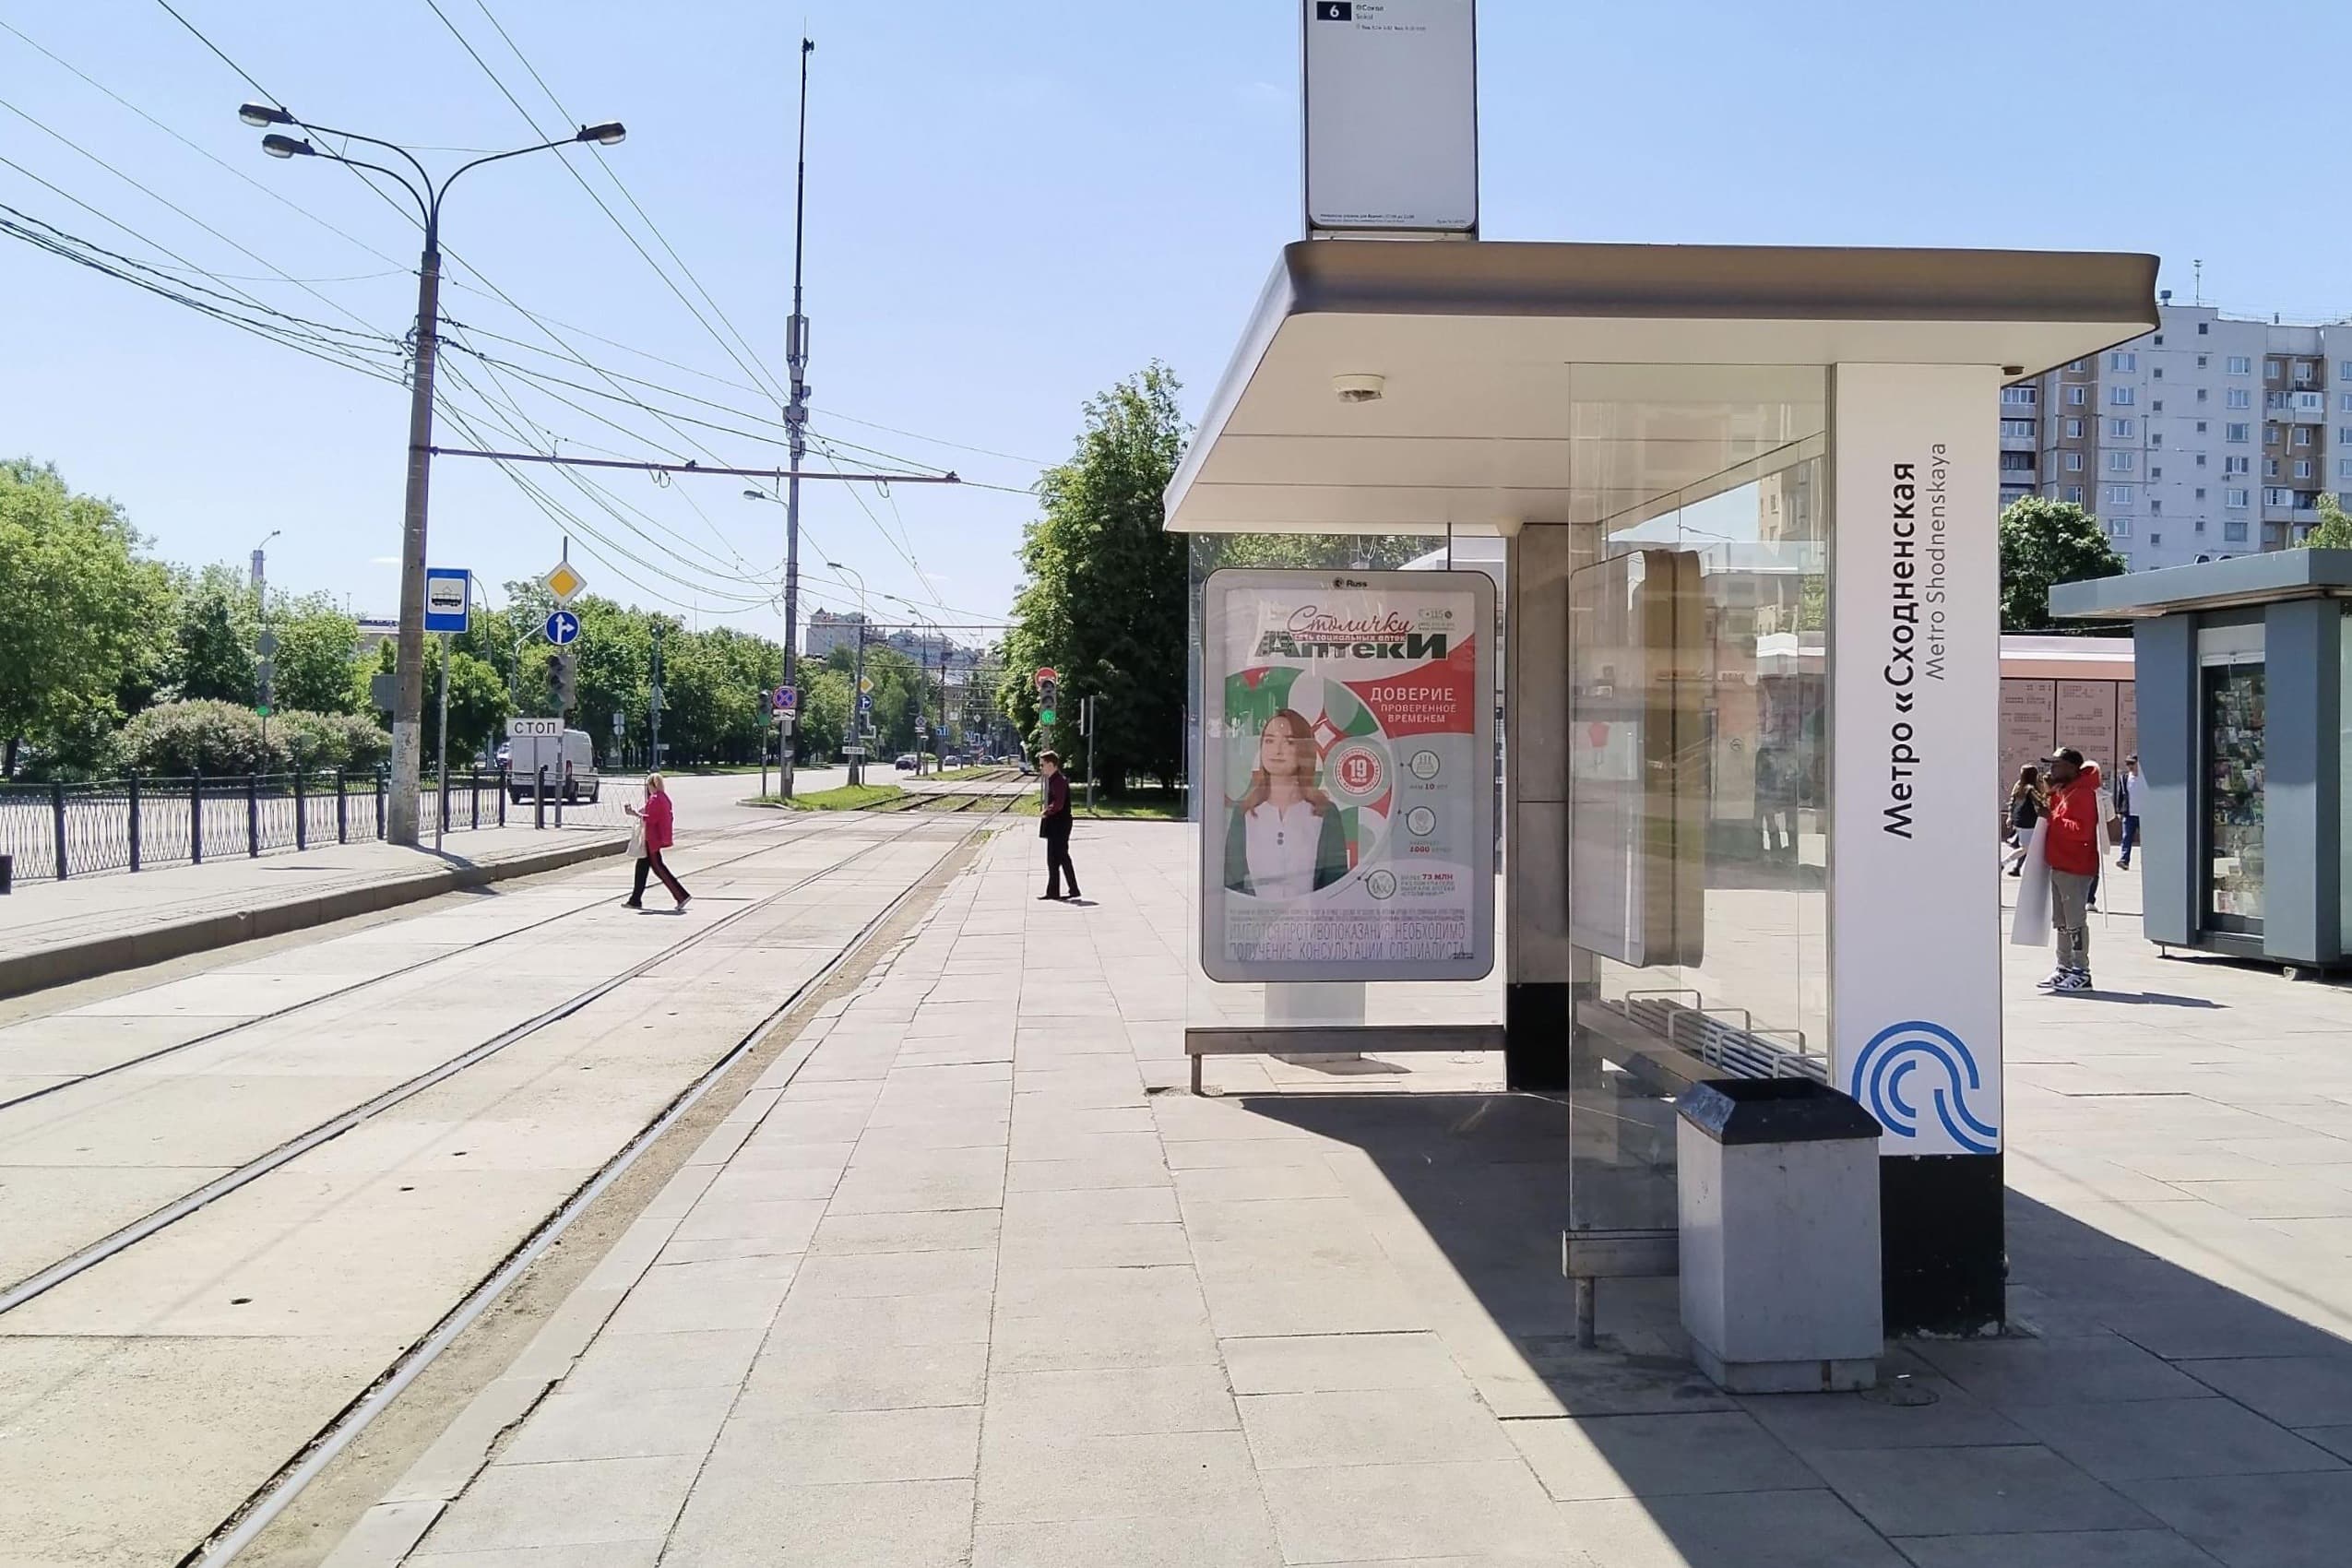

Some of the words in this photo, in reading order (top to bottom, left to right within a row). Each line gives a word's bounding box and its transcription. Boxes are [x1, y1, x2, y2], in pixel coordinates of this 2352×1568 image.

[1329, 6, 1339, 18] 6
[1925, 443, 1951, 602] Shodnenskaya
[1346, 579, 1368, 588] Russ
[1287, 605, 1415, 634] Столички
[1316, 634, 1375, 642] социальных
[1925, 609, 1945, 681] Metro
[1371, 687, 1454, 703] ДОВЕРИЕ
[1381, 703, 1457, 714] ПРОВЕРЕННОЕ
[1387, 714, 1446, 723] ВРЕМЕНЕМ
[514, 720, 557, 737] СТОП
[1348, 759, 1368, 778] 19
[1425, 782, 1435, 790] 10
[1883, 721, 1919, 839] Метро
[1395, 922, 1466, 941] НЕОБХОДИМО
[1229, 942, 1292, 960] ПОЛУЧЕНИЕ
[1300, 942, 1384, 960] КОНСУЛЬТАЦИИ
[1389, 942, 1466, 960] СПЕЦИАЛИСТА
